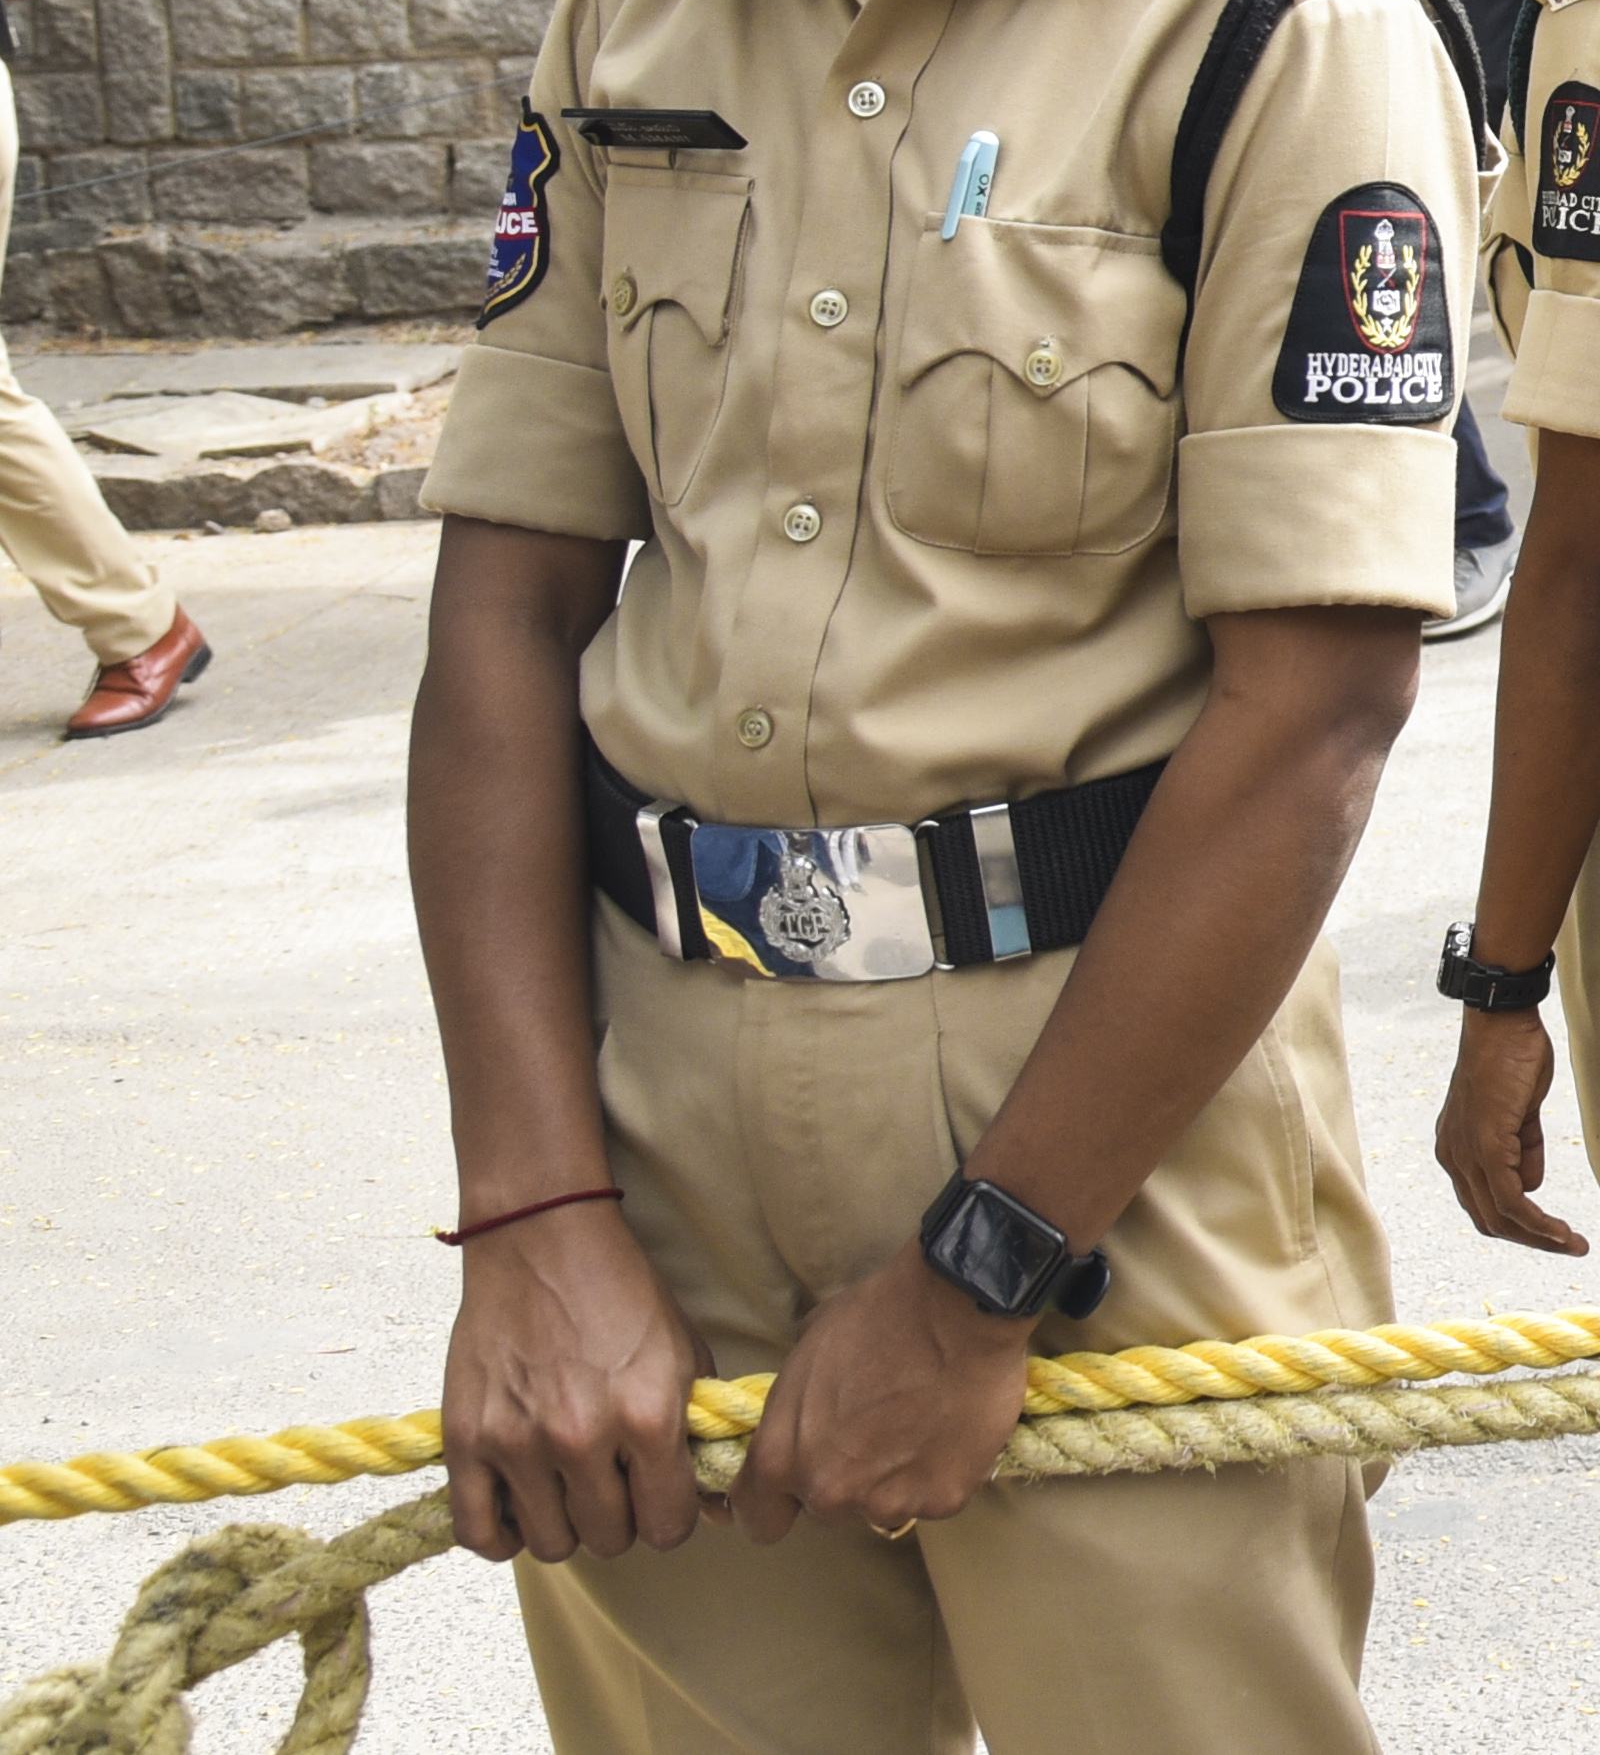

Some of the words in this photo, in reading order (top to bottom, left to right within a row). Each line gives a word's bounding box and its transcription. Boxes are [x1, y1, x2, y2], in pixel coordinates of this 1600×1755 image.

[1307, 352, 1414, 378] HYDERABAD
[1416, 352, 1443, 378] CITY
[1303, 374, 1443, 404] POLICE
